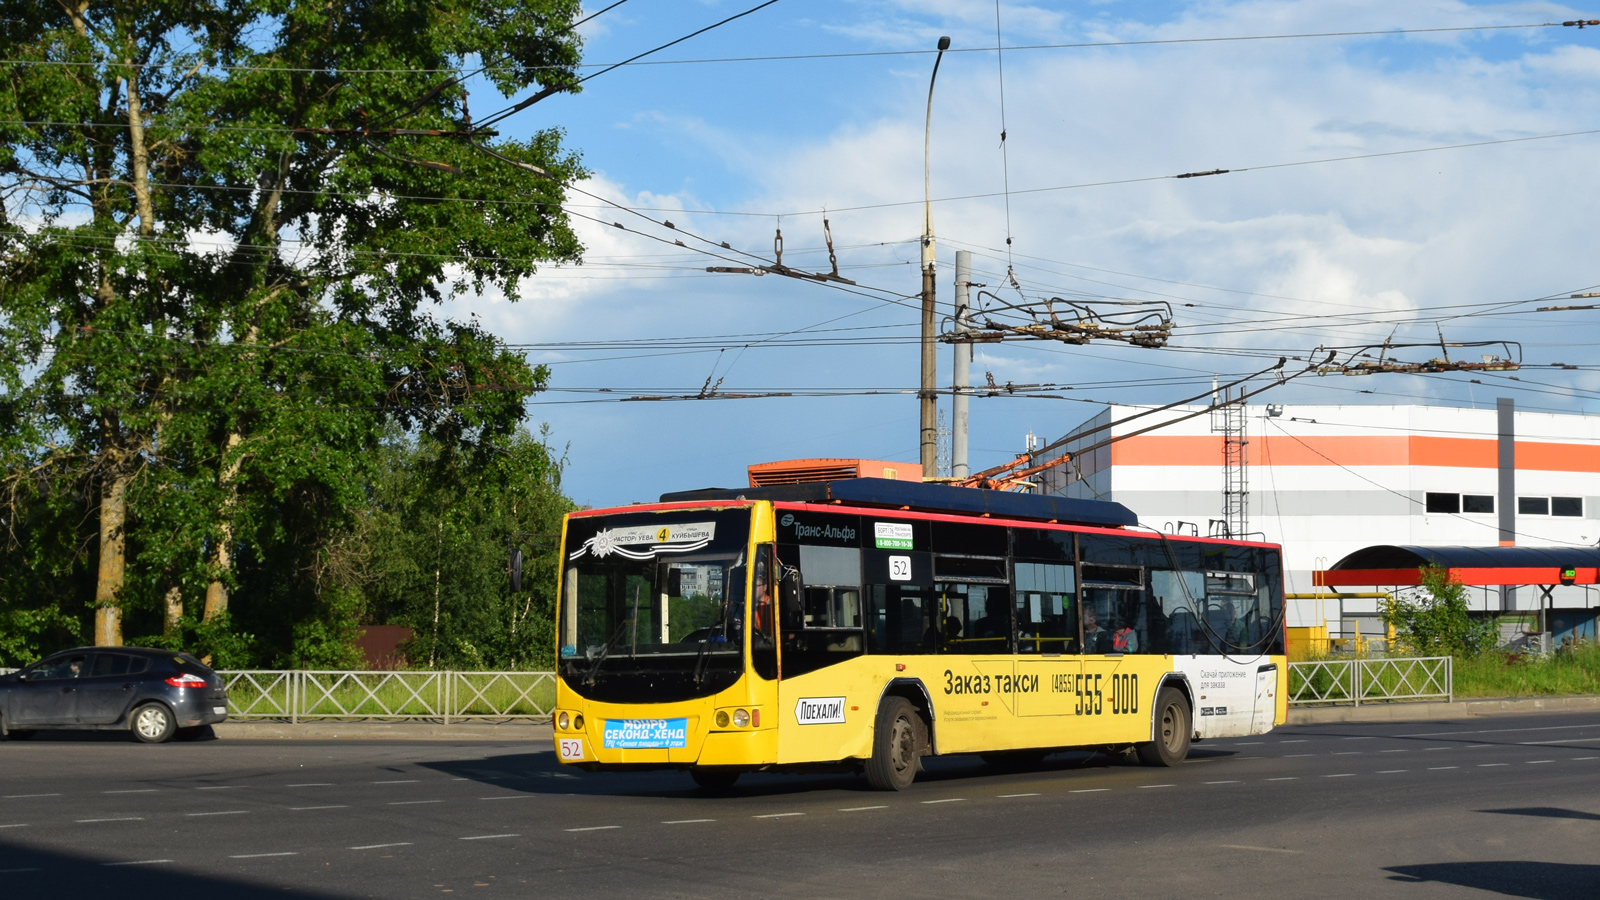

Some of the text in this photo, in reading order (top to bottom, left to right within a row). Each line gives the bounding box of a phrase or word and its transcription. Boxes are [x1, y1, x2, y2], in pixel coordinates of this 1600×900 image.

[659, 529, 667, 541] 4
[671, 531, 710, 539] КУЙБЫШЕВА
[794, 522, 856, 542] Транс-Альфа
[893, 561, 907, 575] 52
[1201, 670, 1246, 679] Скачай приложение
[943, 669, 1039, 695] Заказ такси
[1201, 682, 1209, 690] для
[1075, 674, 1102, 716] 555
[1112, 673, 1138, 714] 000
[623, 719, 668, 730] МОНРО
[605, 729, 685, 740] СЕКОНД-ХЕНД
[562, 741, 581, 757] 52
[605, 740, 616, 748] ТРЦ
